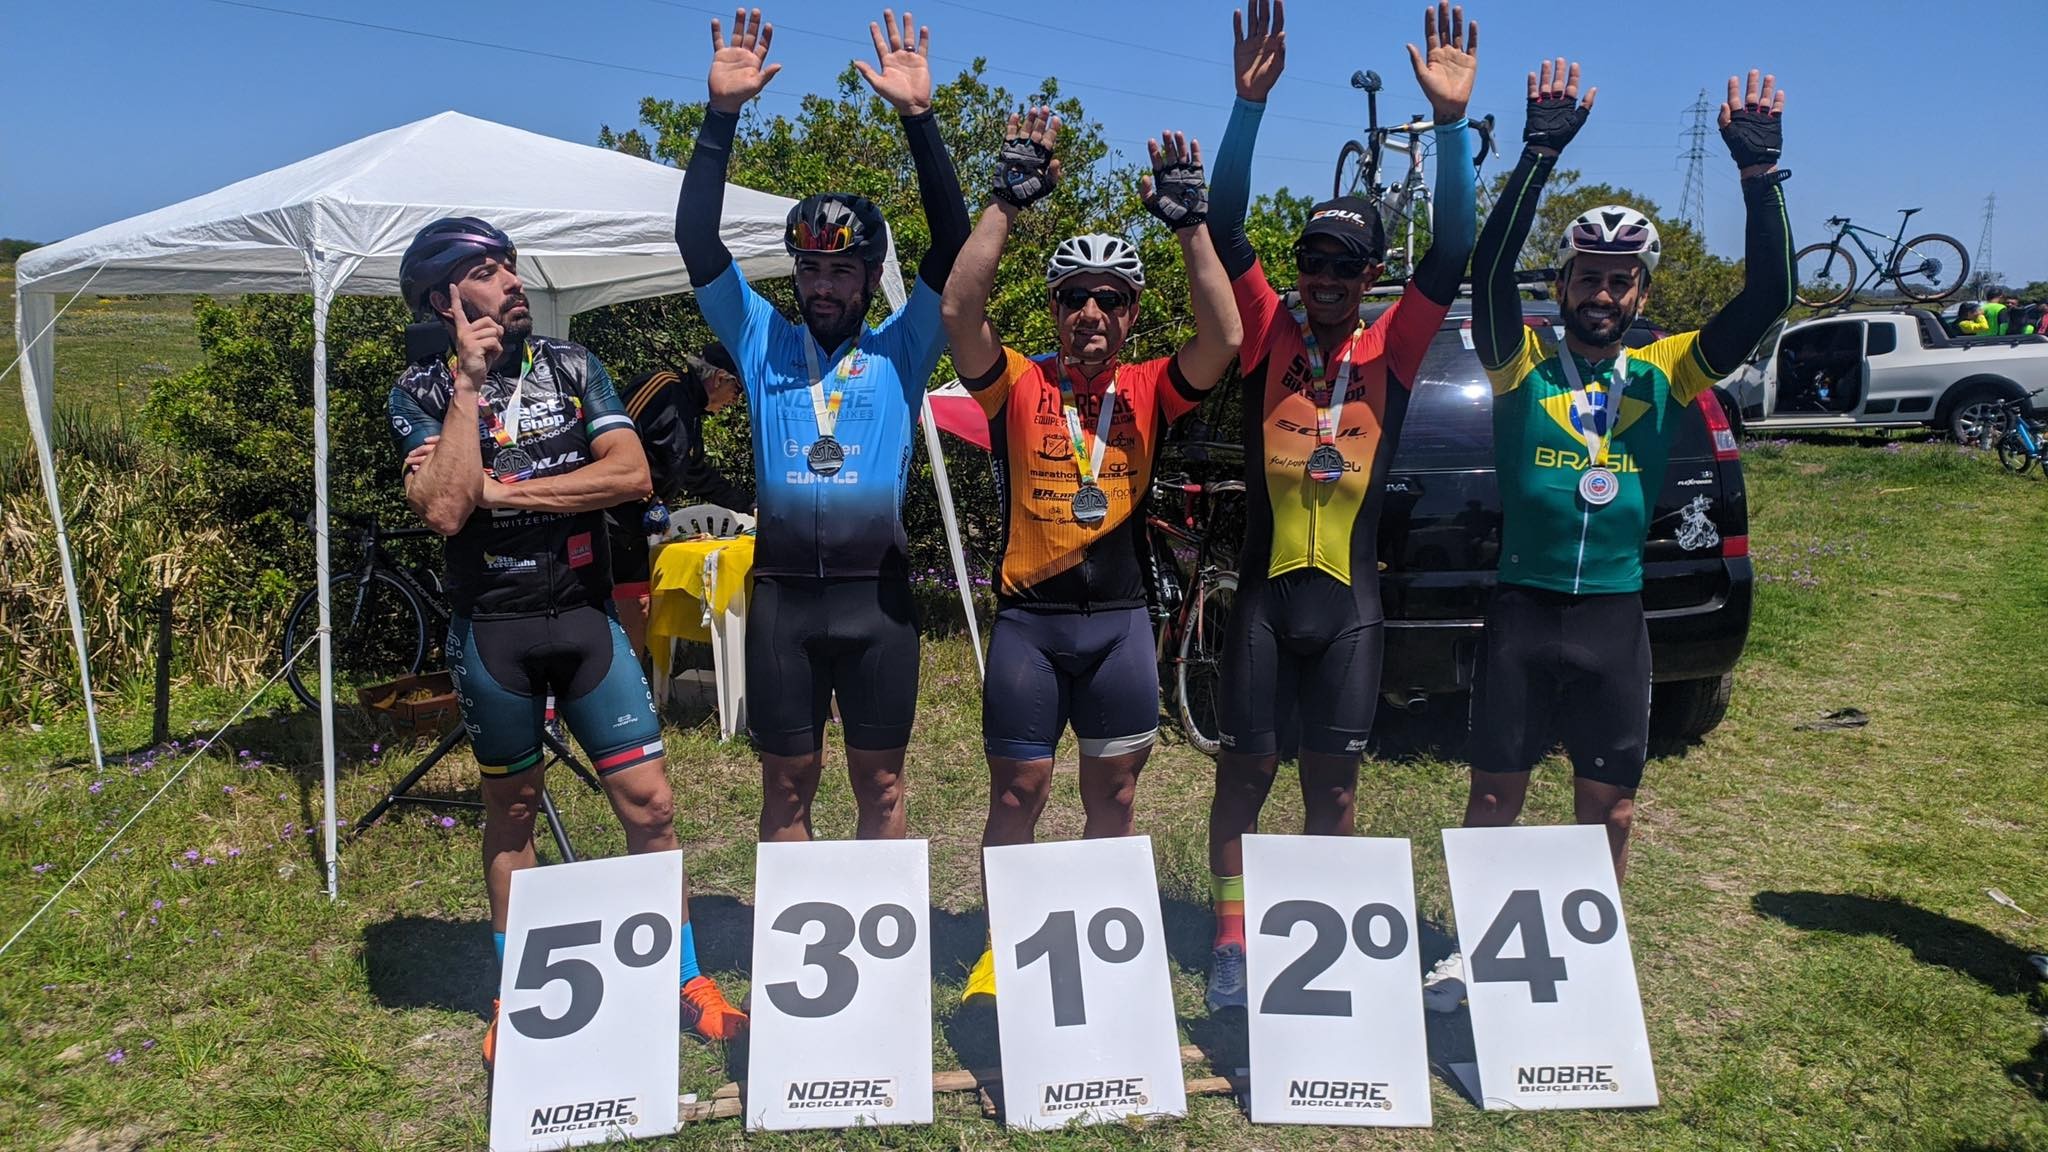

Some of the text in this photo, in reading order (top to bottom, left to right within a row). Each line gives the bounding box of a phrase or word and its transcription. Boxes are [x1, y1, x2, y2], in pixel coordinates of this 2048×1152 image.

[520, 414, 566, 433] Shop
[493, 511, 577, 529] SWITZERLAND
[1517, 1065, 1613, 1085] NOBRE
[787, 1079, 891, 1100] NOBRE
[1044, 1077, 1144, 1104] NOBRE
[1289, 1080, 1389, 1100] NOBRE
[1519, 1084, 1609, 1093] BICICLETAS
[531, 1097, 637, 1128] NOBRE
[788, 1099, 883, 1109] BICICLETAS
[1046, 1097, 1138, 1112] BICICLETAS
[1291, 1099, 1382, 1109] BICICLETAS
[532, 1118, 629, 1135] BICICLETAS
